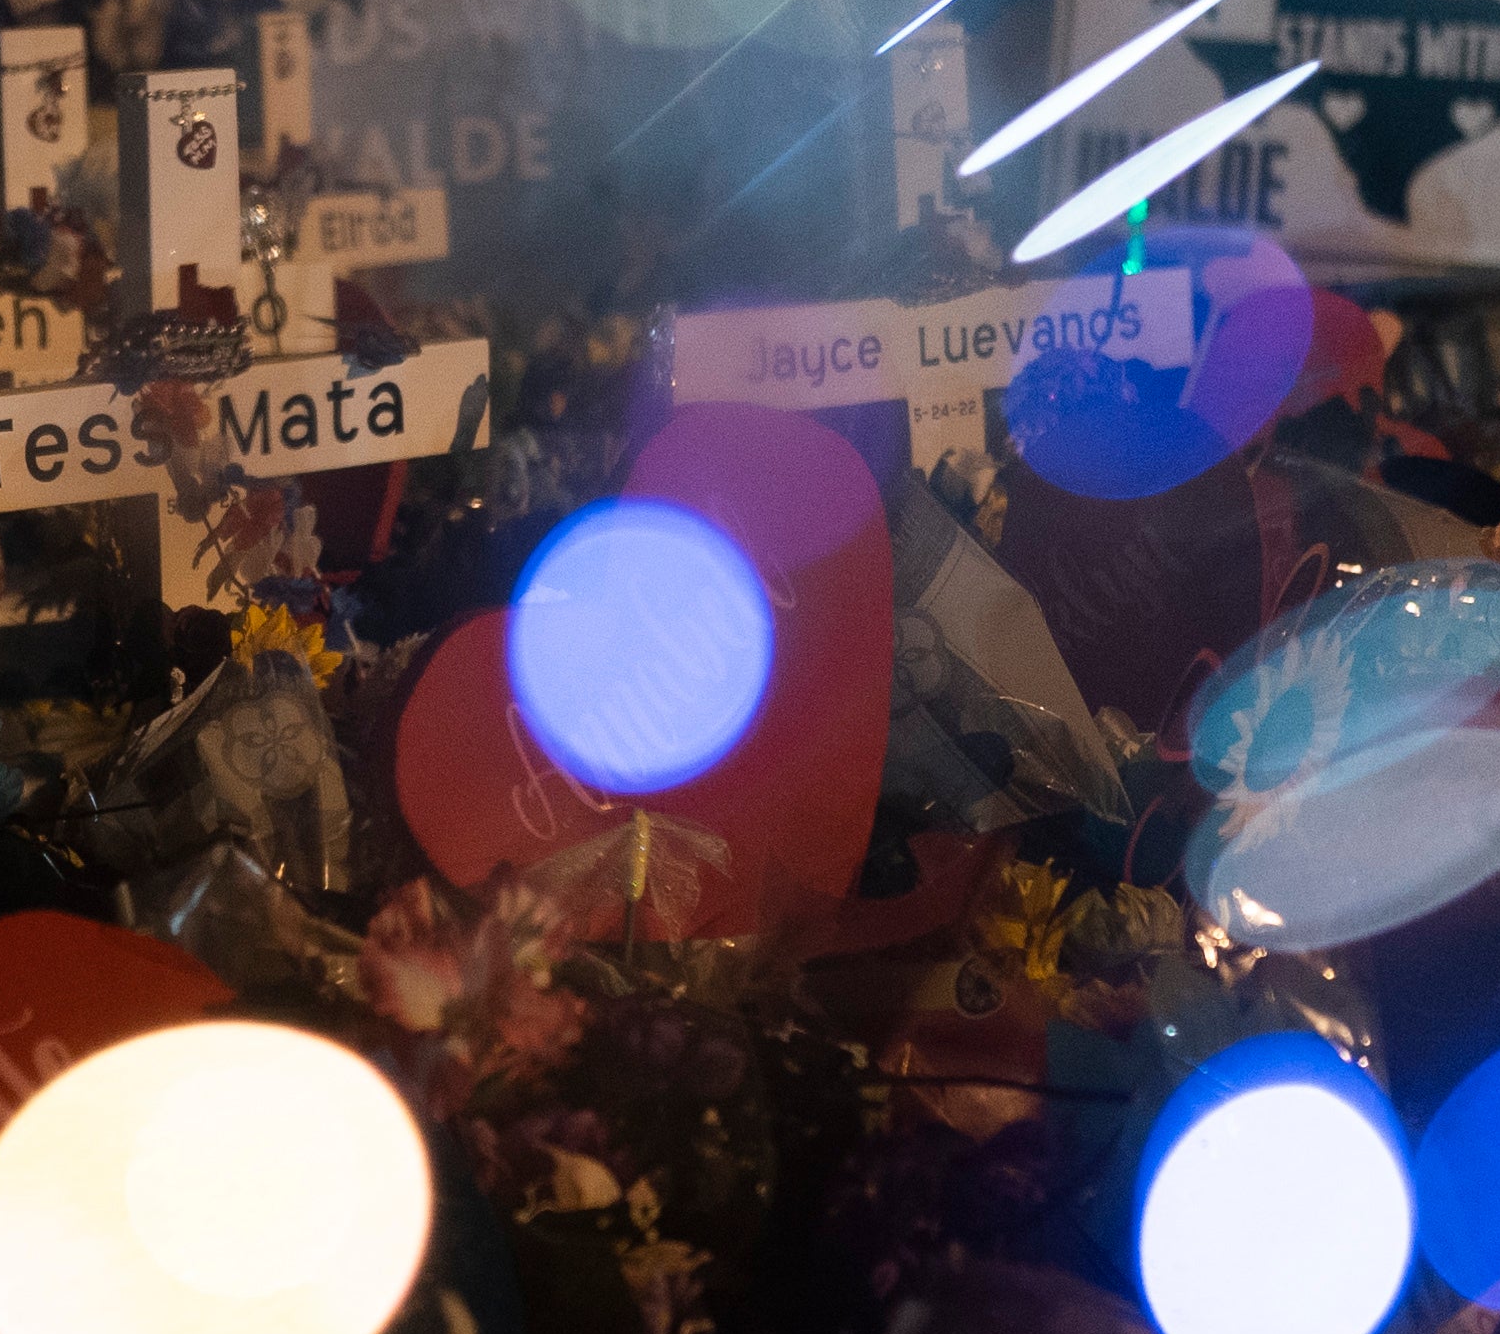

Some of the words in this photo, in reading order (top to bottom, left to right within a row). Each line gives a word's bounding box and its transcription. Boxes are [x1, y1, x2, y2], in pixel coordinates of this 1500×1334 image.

[1278, 15, 1408, 77] STANDS
[319, 207, 419, 255] Elrod
[747, 327, 883, 388] Jayce
[917, 301, 1142, 367] Luevanos
[218, 379, 405, 456] Mata
[912, 399, 978, 424] 5-24-22
